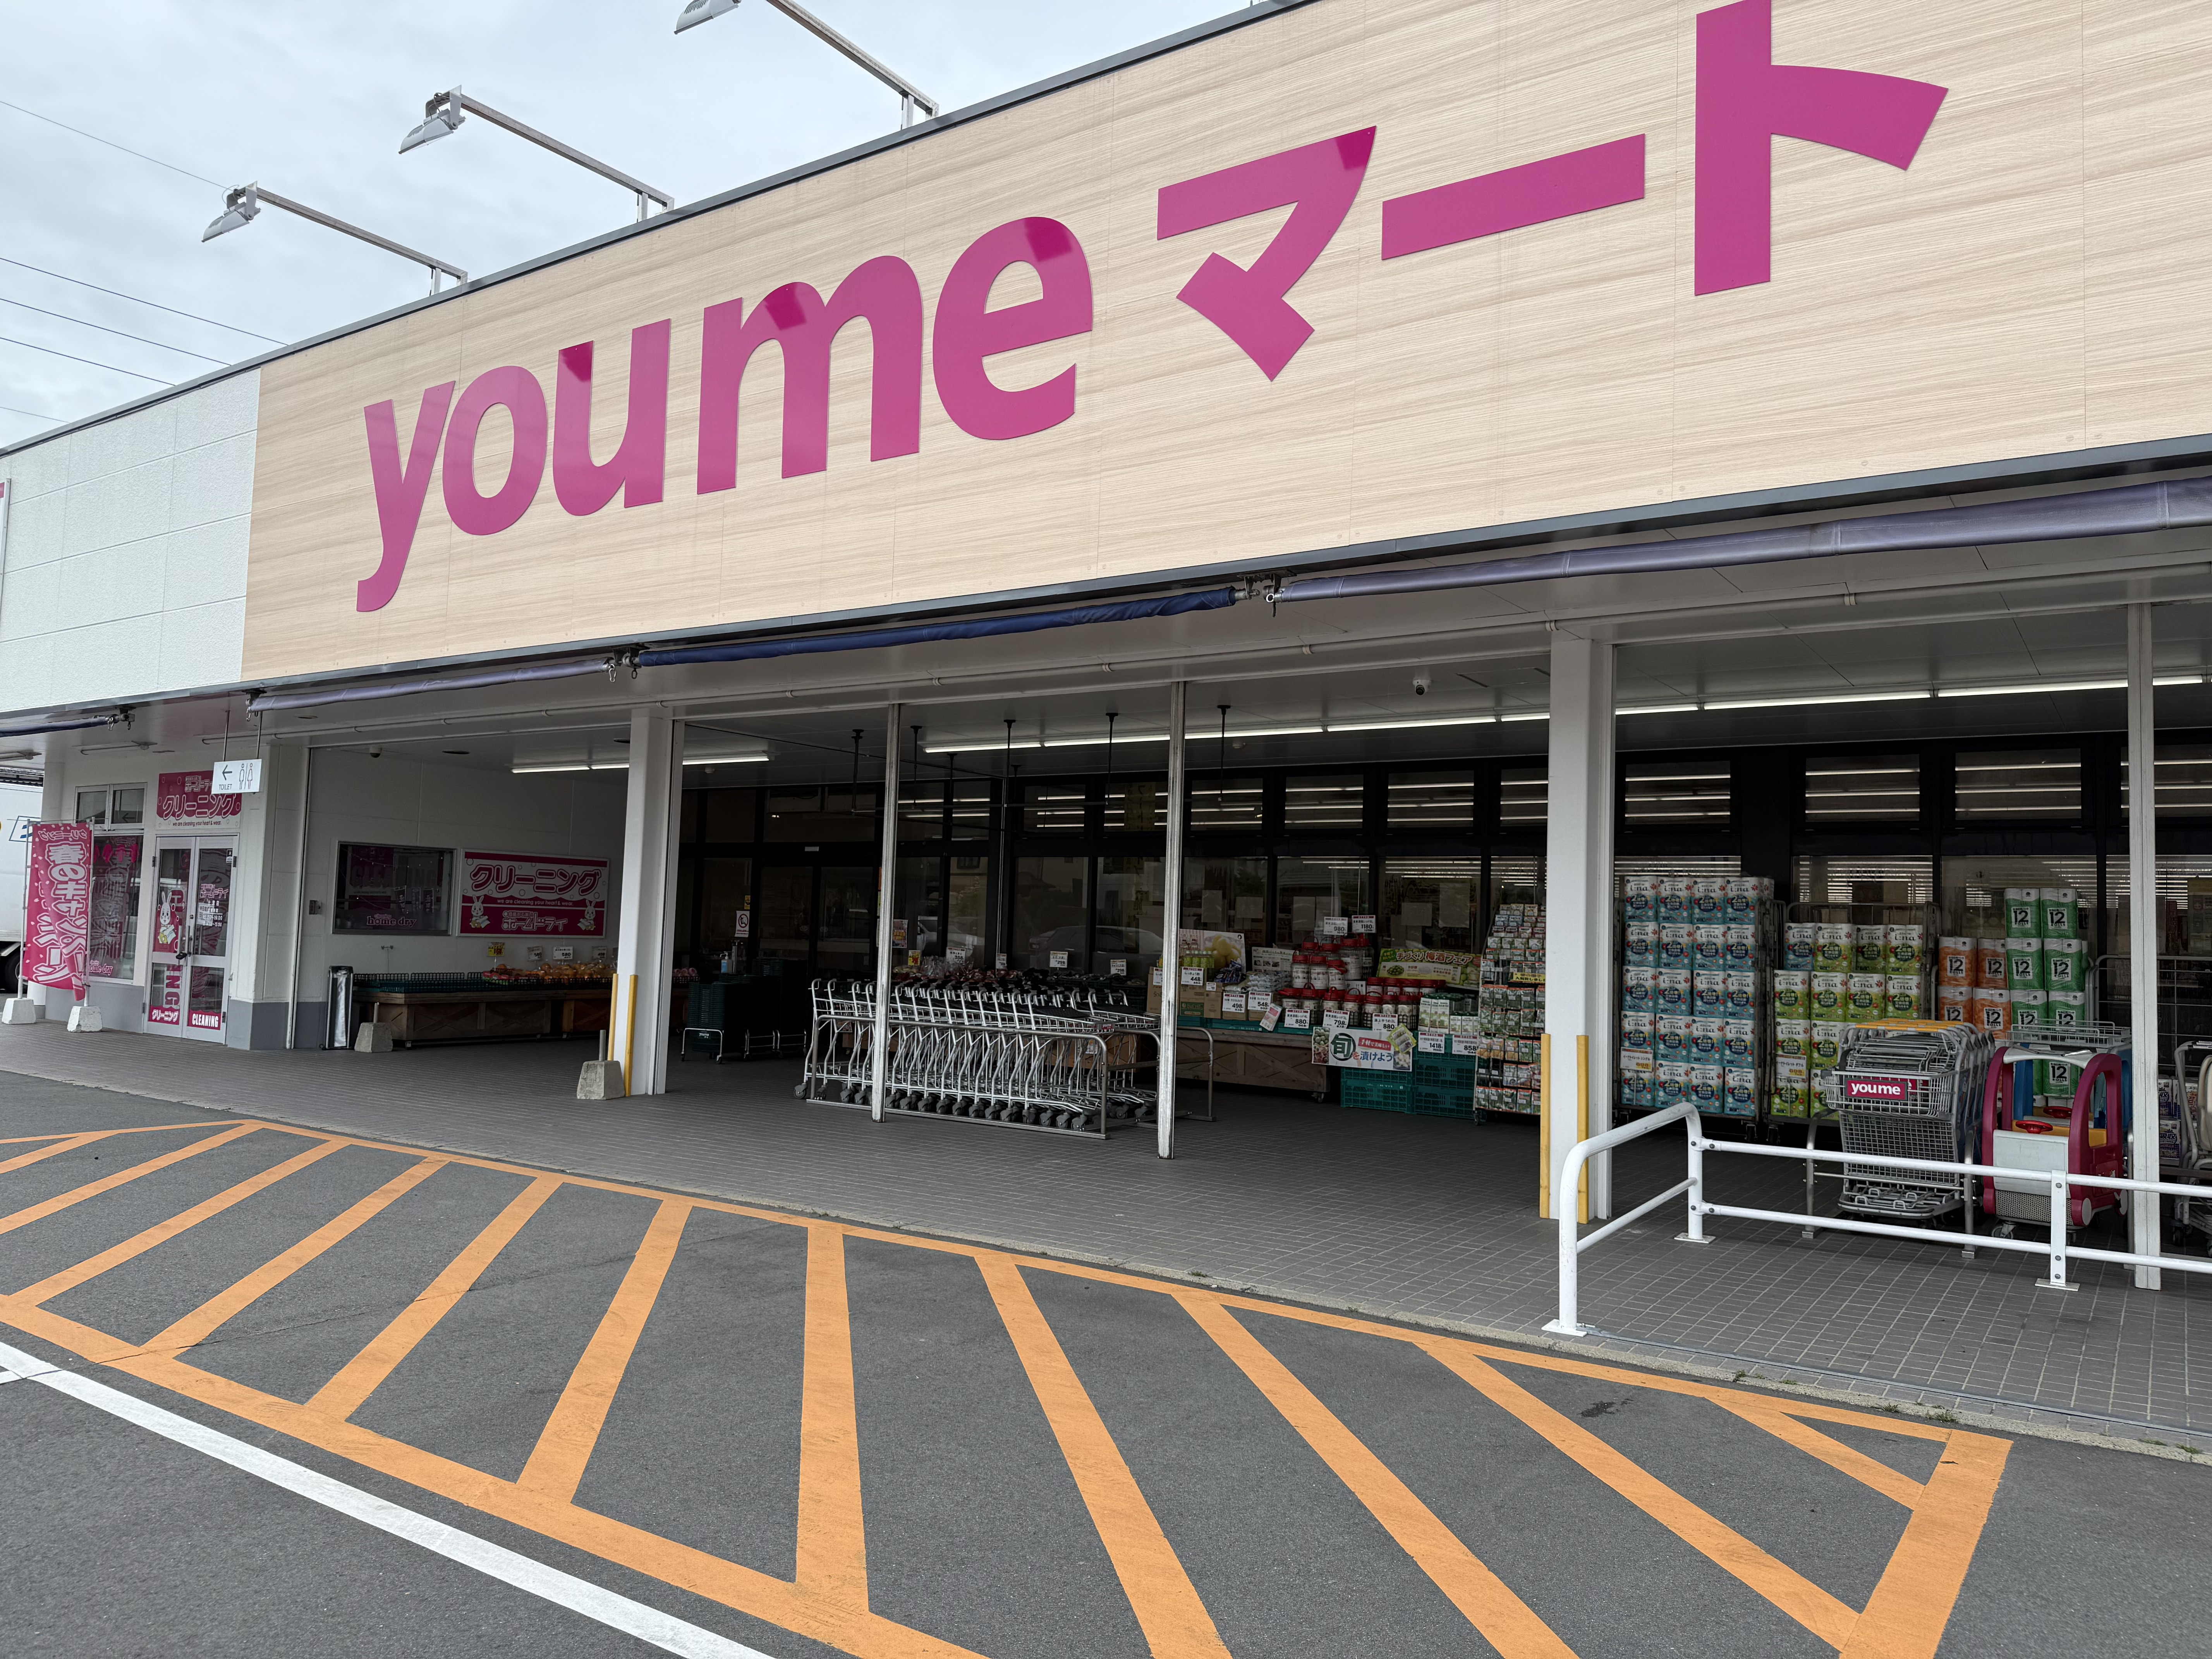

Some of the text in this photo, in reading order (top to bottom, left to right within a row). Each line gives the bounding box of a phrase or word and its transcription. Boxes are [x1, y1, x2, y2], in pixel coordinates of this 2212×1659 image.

[357, 0, 1949, 614] youme マート
[163, 794, 236, 820] クリーニング
[470, 864, 601, 896] クリーニング
[367, 915, 417, 927] home dry
[502, 912, 568, 931] ホームドライ
[2014, 910, 2028, 922] 12
[2050, 912, 2065, 924] 12
[1949, 959, 1963, 971] 12
[1988, 961, 2002, 973] 12
[2014, 961, 2030, 974] 12
[2053, 962, 2069, 975] 12
[152, 1009, 179, 1022] クリーニング
[192, 1013, 218, 1027] CLEANING
[1947, 1009, 1961, 1021] 12
[1987, 1011, 2001, 1024] 12
[2020, 1014, 2035, 1025] 12
[2058, 1013, 2073, 1025] 12
[1361, 1039, 1389, 1049] 手軽で美味しい
[2051, 1066, 2067, 1079] 12
[1851, 1083, 1901, 1095] youme
